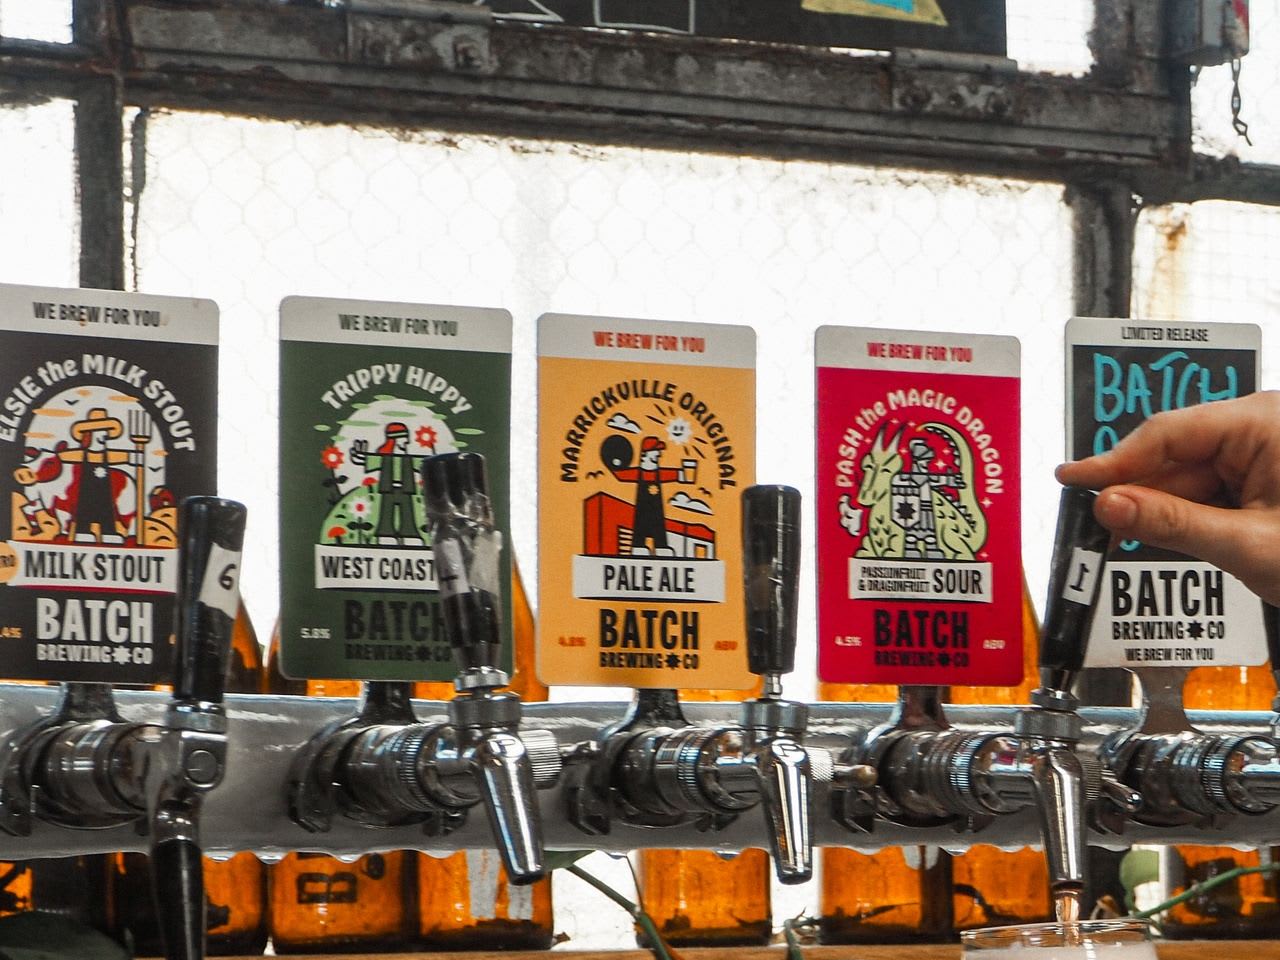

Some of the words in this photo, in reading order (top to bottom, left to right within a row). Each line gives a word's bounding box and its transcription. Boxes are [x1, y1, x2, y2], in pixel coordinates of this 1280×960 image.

[33, 301, 56, 320] WE
[60, 303, 99, 324] BREW
[104, 305, 130, 326] FOR
[134, 308, 160, 327] YOU
[338, 314, 360, 331] WE
[363, 314, 401, 333] BREW
[405, 317, 429, 335] FOR
[432, 319, 458, 337] YOU
[593, 331, 613, 348] WE
[616, 332, 652, 350] BREW
[656, 335, 678, 351] FOR
[681, 336, 705, 352] YOU
[1121, 326, 1164, 341] LIMITED
[1166, 328, 1209, 342] RELEASE
[867, 342, 886, 358] WE
[890, 343, 923, 359] BREW
[926, 344, 948, 361] FOR
[951, 346, 973, 362] YOU
[321, 363, 401, 410] TRIPPY
[405, 365, 474, 415] HIPPY
[0, 375, 43, 443] ELSIE
[37, 360, 79, 387] the
[82, 353, 147, 389] MILK
[143, 379, 197, 452] STOUT
[560, 379, 678, 483] MARRICKVILLE
[678, 392, 737, 490] ORIGINAL
[836, 427, 864, 487] PASH
[855, 400, 887, 430] the
[887, 388, 957, 415] MAGIC
[954, 404, 1004, 495] DRAGON
[25, 550, 87, 580] MILK
[94, 553, 165, 583] STOUT
[218, 563, 238, 590] 6
[322, 555, 373, 581] WEST
[379, 556, 436, 583] COAST
[604, 565, 653, 592] PALE
[658, 566, 695, 593] ALE
[861, 566, 926, 580] PASSIONFRUIT
[867, 580, 930, 593] DRAGONFRUIT
[933, 568, 983, 594] SOUR
[1111, 570, 1225, 616] BATCH
[37, 598, 153, 643] BATCH
[344, 599, 450, 642] BATCH
[600, 608, 699, 650] BATCH
[874, 609, 969, 648] BATCH
[1112, 621, 1184, 640] BREWING
[1208, 621, 1225, 640] CO
[37, 644, 111, 663] BREWING
[132, 647, 153, 664] CO
[600, 652, 663, 669] BREWING
[683, 653, 699, 670] CO
[875, 651, 935, 667] BREWING
[1125, 647, 1142, 661] WE
[1144, 647, 1171, 661] BREW
[1175, 648, 1193, 661] FOR
[1196, 648, 1214, 661] YOU
